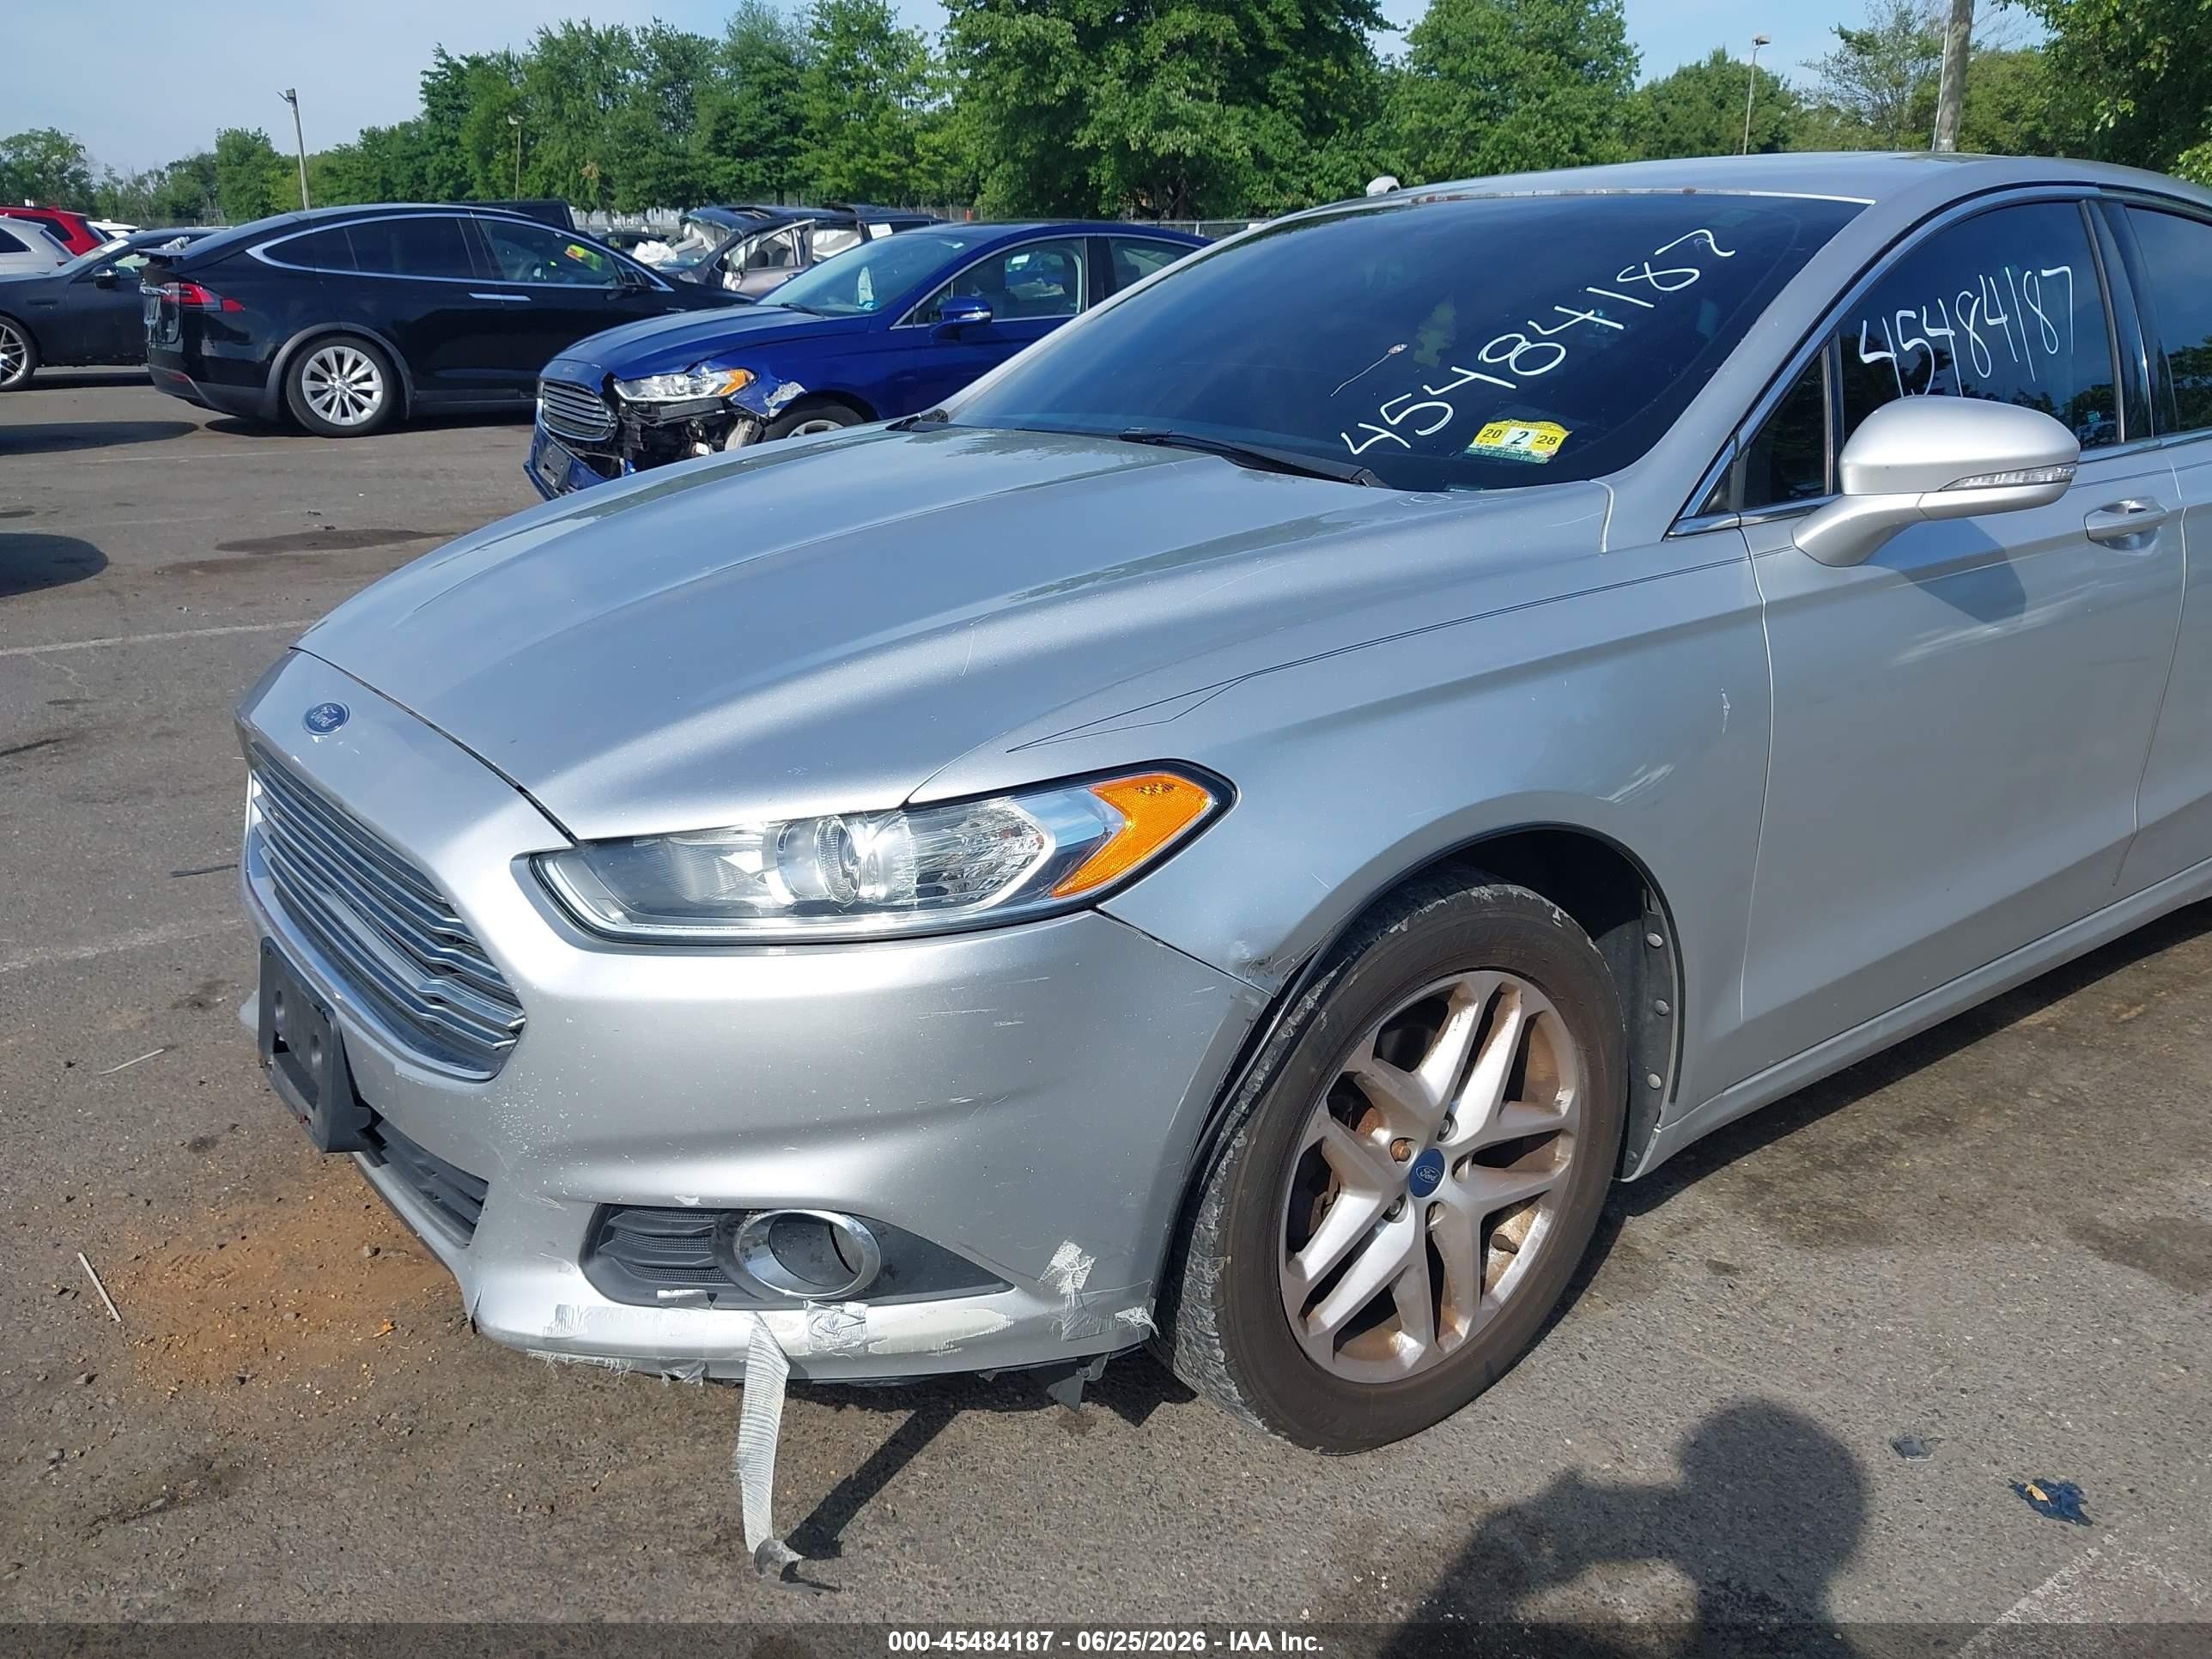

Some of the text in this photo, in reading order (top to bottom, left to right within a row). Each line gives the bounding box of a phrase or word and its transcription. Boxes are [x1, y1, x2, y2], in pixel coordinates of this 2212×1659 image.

[1858, 265, 2074, 398] 45484187
[1482, 428, 1559, 446] 20 2 28
